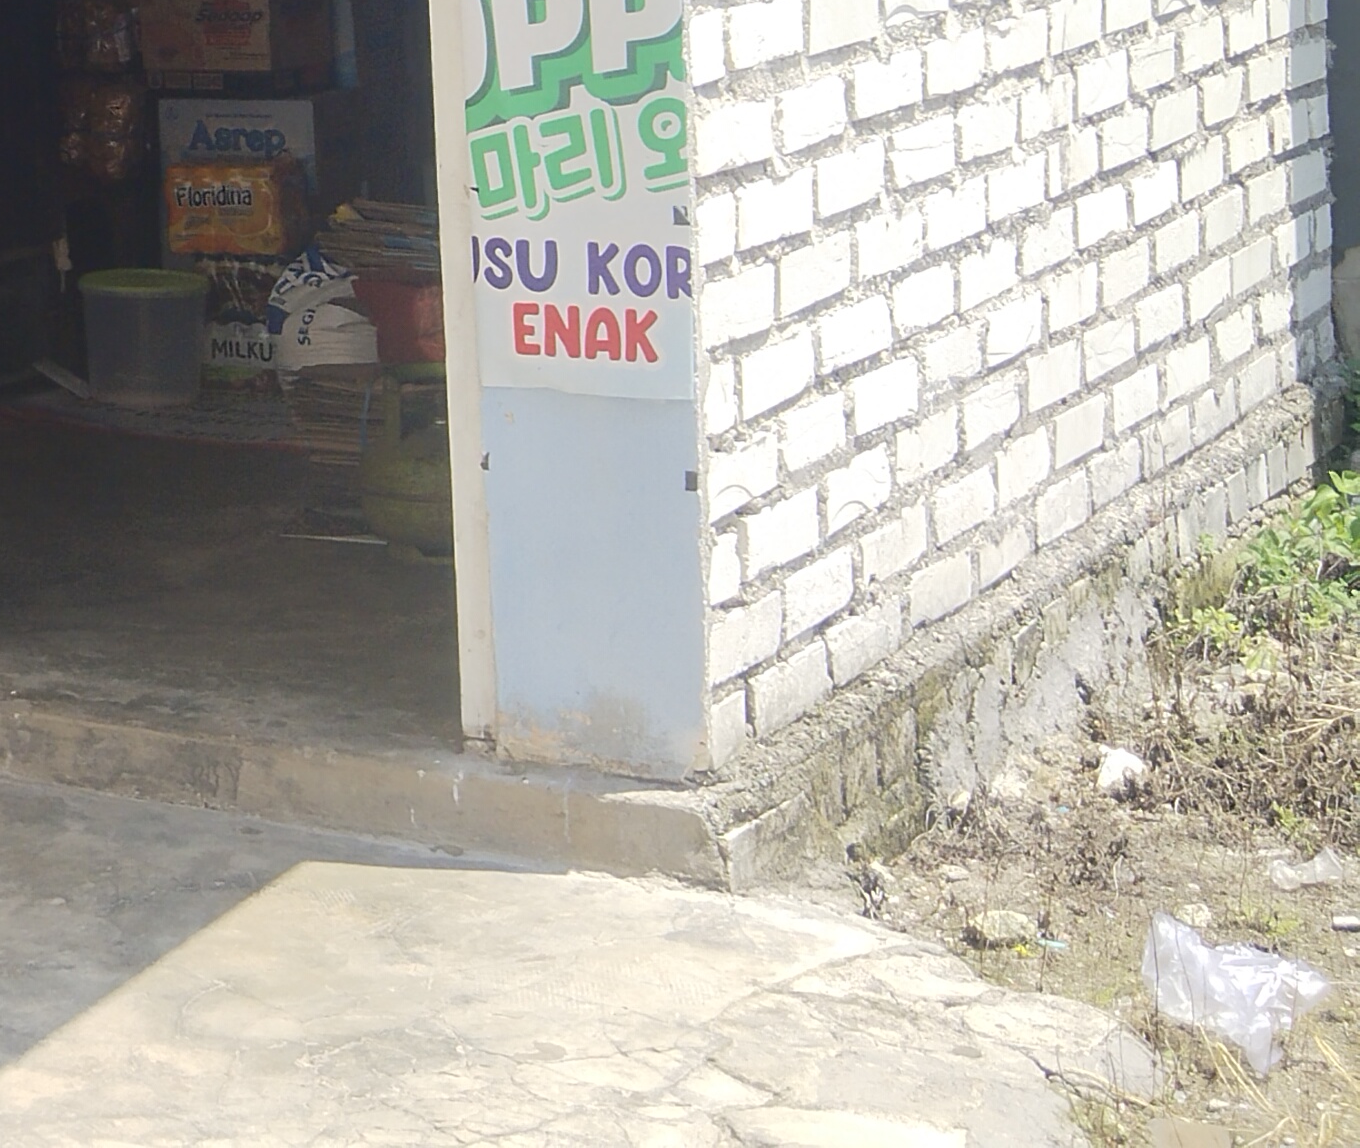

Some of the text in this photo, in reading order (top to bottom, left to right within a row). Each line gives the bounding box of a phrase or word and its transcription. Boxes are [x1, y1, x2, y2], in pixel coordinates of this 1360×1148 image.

[470, 107, 626, 221] 마리
[176, 185, 252, 208] Floridina
[472, 236, 558, 292] SU
[211, 337, 276, 362] MILKU
[513, 302, 659, 363] ENAK
